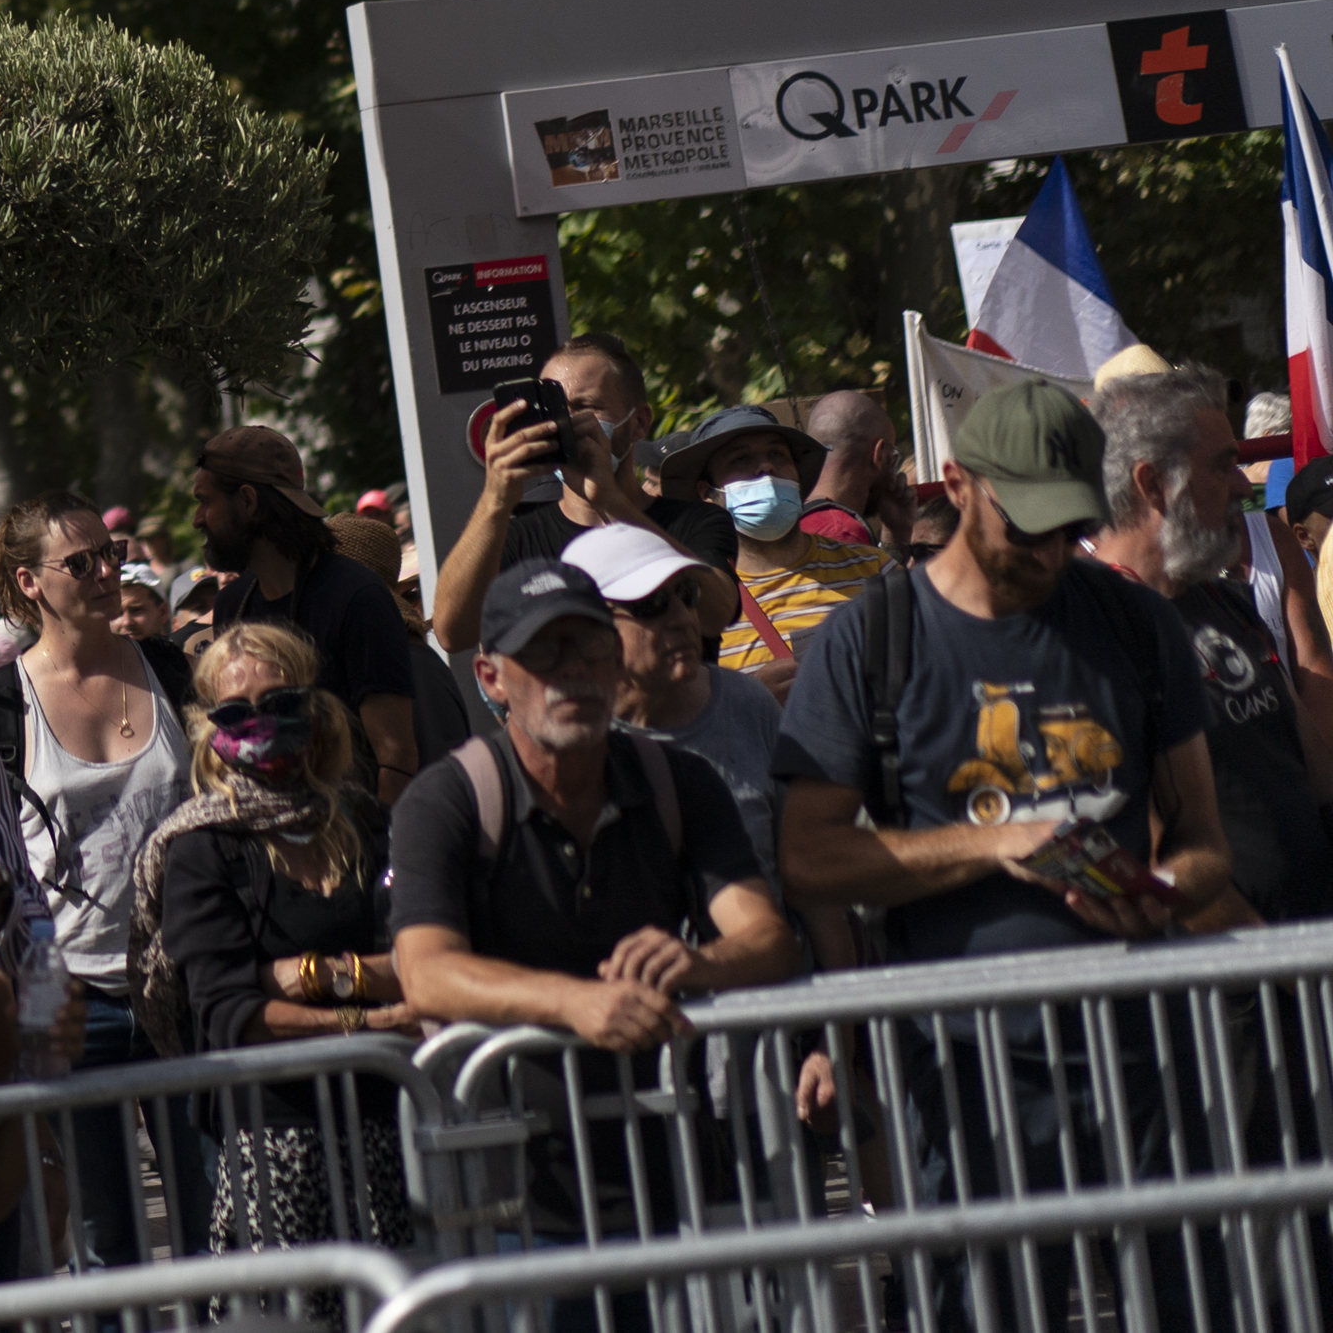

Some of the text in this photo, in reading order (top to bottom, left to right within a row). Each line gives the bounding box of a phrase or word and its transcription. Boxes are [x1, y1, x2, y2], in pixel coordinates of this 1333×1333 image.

[618, 106, 725, 134] MARSEILLE
[620, 125, 727, 153] PROVENCE
[623, 143, 729, 170] METROPOLE
[476, 263, 543, 280] INFORMATION
[453, 297, 528, 316] L'ASCENSEUR
[448, 314, 538, 336] NE DESSERT PAS
[459, 341, 472, 354] LE
[474, 335, 518, 352] NIVEAU
[462, 354, 533, 372] DU PARKING
